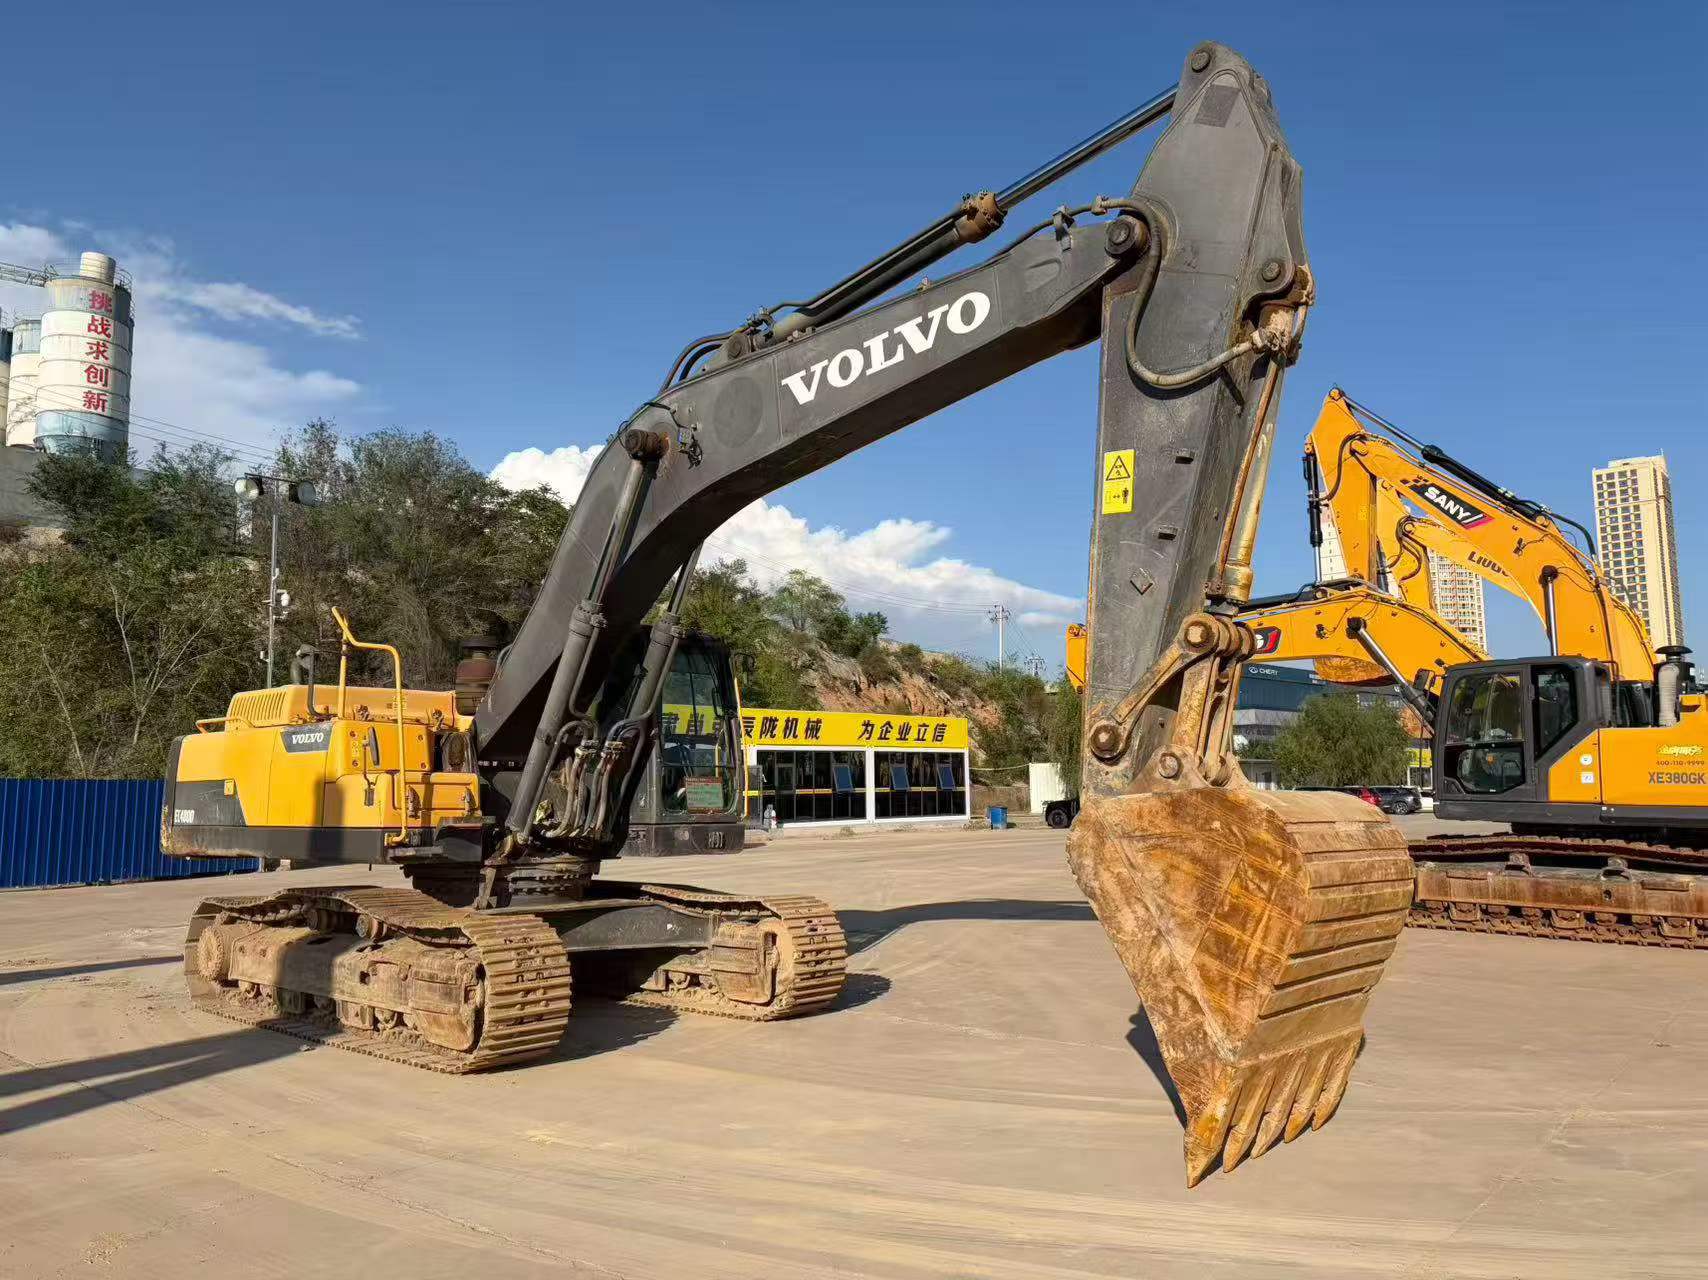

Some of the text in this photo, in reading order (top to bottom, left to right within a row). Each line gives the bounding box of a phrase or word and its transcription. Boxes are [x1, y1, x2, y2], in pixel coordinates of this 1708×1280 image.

[83, 290, 112, 413] 挑战求创新
[781, 291, 991, 405] VOLVO
[1424, 486, 1471, 520] SANY
[291, 732, 324, 745] VOLVO
[857, 719, 948, 743] 为企业立信
[1648, 771, 1707, 784] XE380GK
